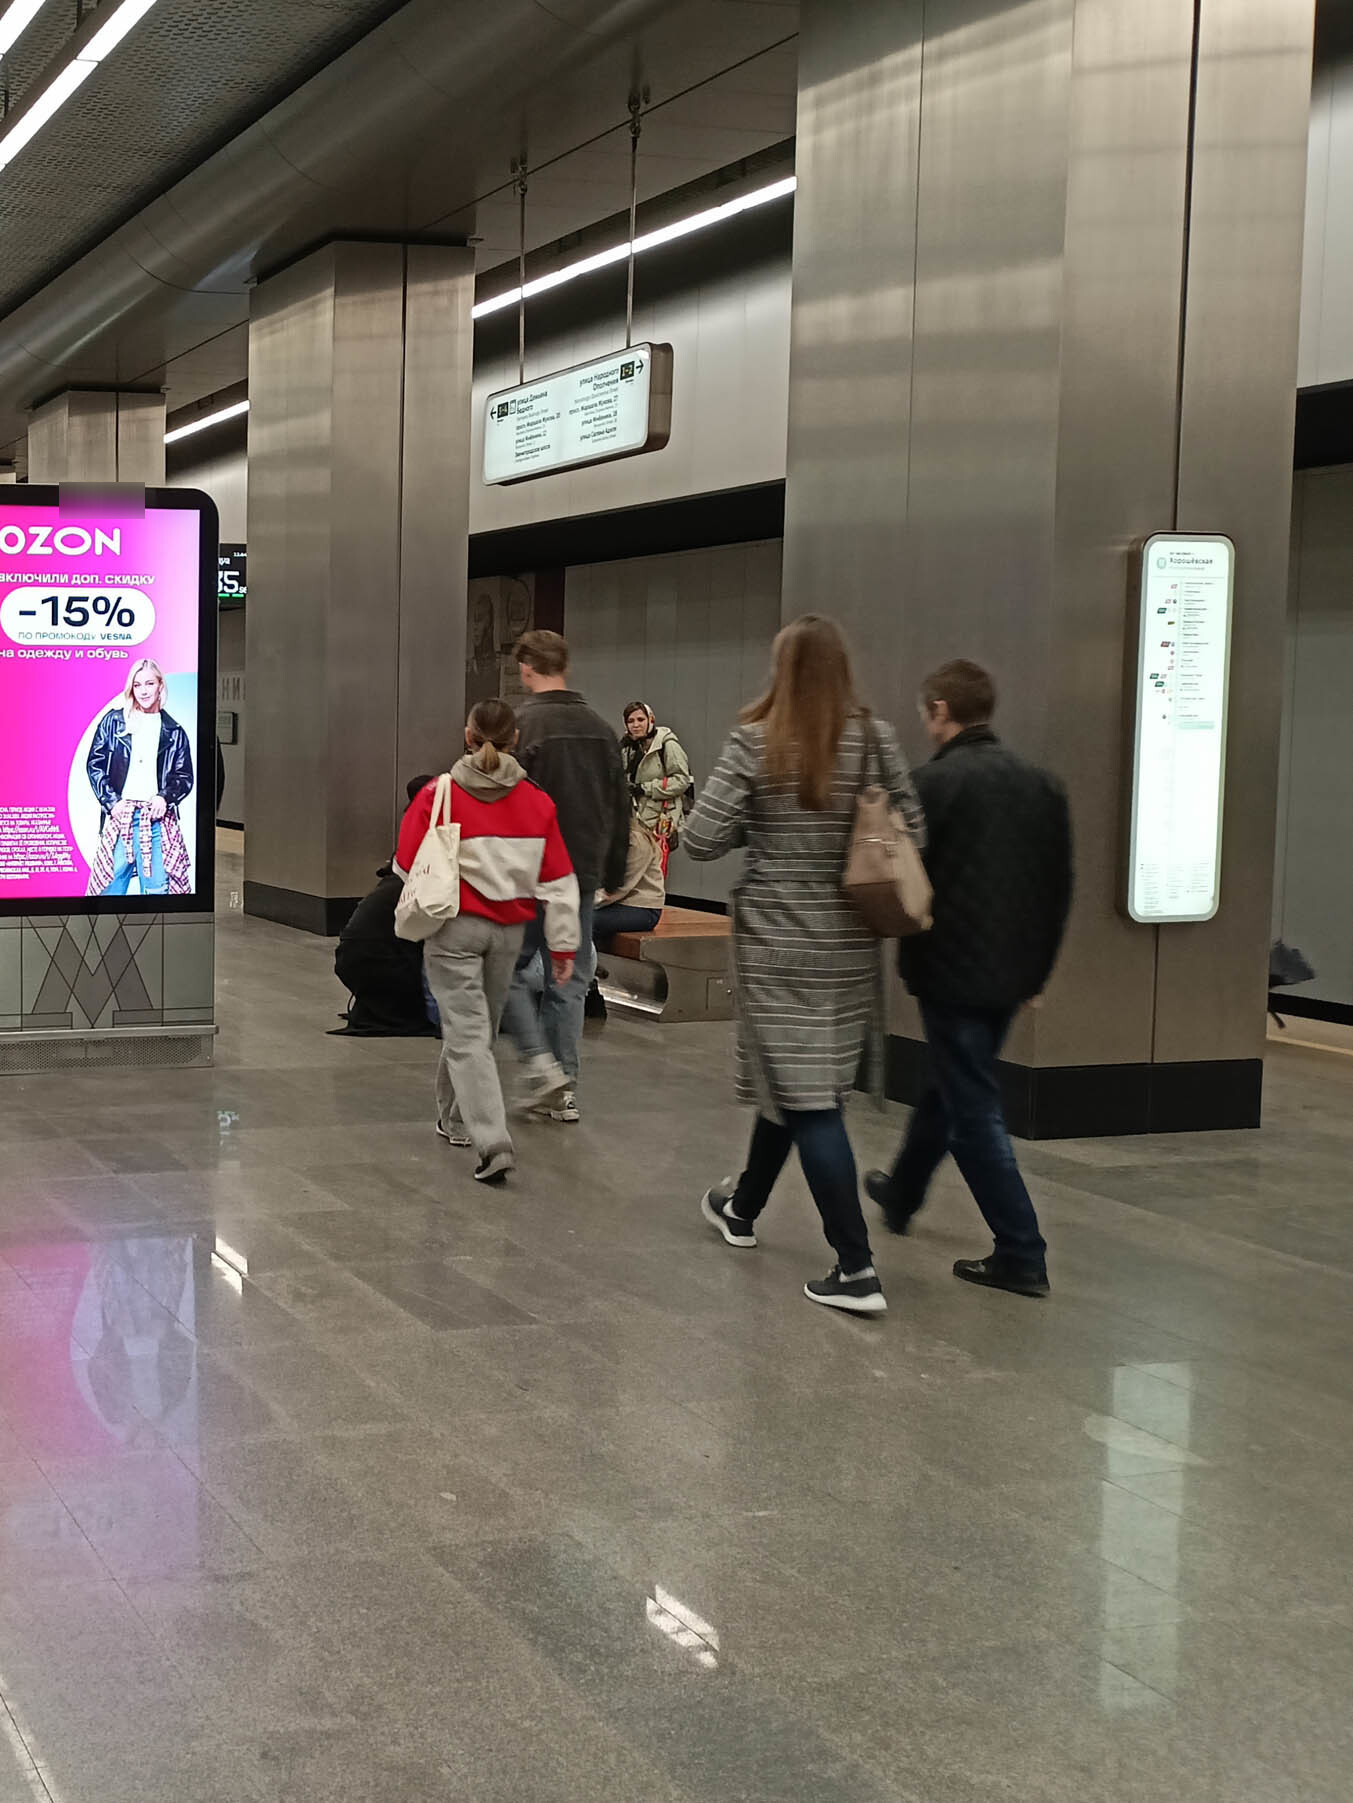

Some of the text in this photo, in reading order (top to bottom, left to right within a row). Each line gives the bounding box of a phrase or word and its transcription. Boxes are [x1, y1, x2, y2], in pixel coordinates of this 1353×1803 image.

[18, 596, 135, 627] -15%
[18, 632, 33, 640] ПО
[100, 633, 133, 641] VESNA
[17, 649, 72, 661] одежду
[75, 649, 84, 659] и
[86, 647, 129, 661] обувь
